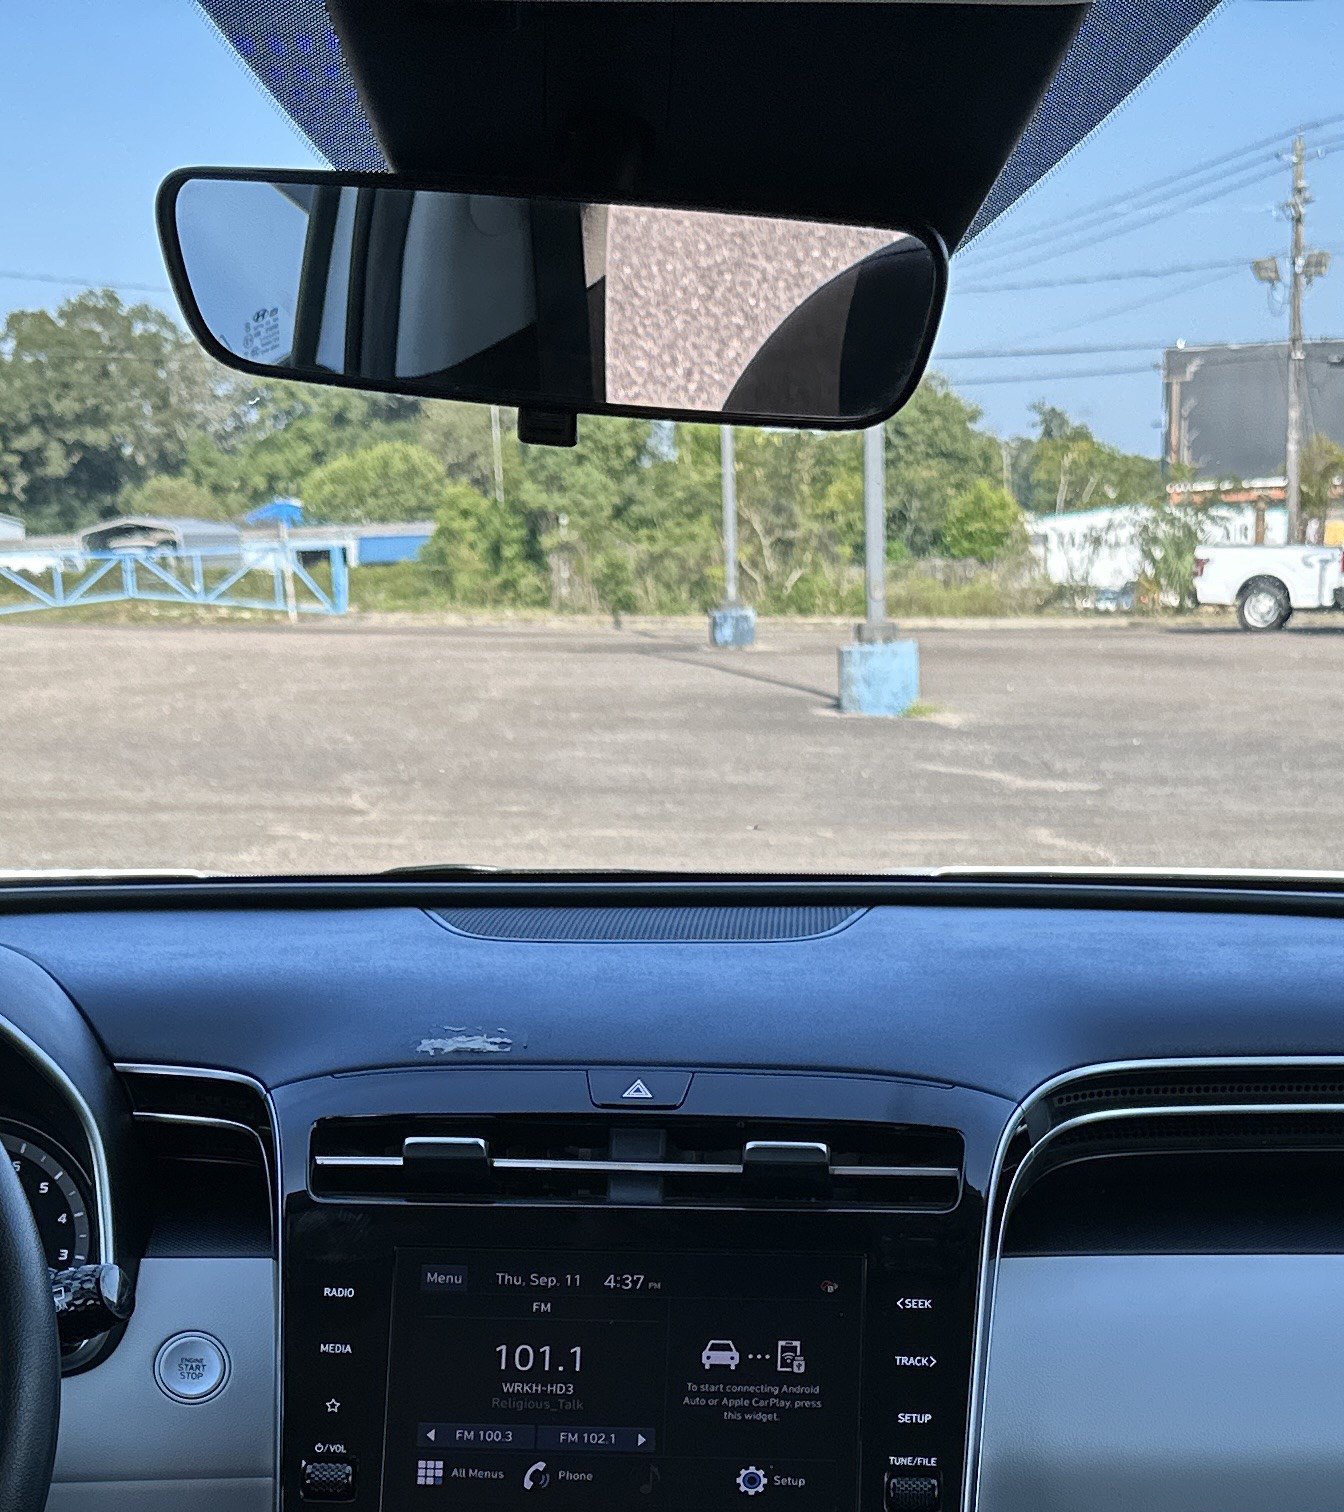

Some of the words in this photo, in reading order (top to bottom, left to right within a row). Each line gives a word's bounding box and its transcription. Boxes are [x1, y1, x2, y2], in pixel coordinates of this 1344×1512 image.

[38, 1182, 49, 1194] 5
[57, 1213, 67, 1224] 4
[58, 1249, 68, 1261] 3
[426, 1272, 462, 1285] Menu
[530, 1273, 560, 1289] Sep.
[565, 1274, 581, 1287] 11
[603, 1274, 645, 1290] 4:37
[323, 1287, 355, 1298] RADIO
[532, 1302, 551, 1313] FM
[904, 1298, 932, 1309] SEEK
[320, 1343, 352, 1354] MEDIA
[495, 1344, 583, 1372] 101.1
[895, 1355, 930, 1367] TRACK
[178, 1364, 206, 1372] START
[180, 1372, 203, 1380] STOP
[502, 1381, 575, 1395] WRKH-HD3
[687, 1382, 698, 1392] To
[700, 1383, 724, 1392] start
[725, 1383, 779, 1395] connecting
[781, 1384, 820, 1395] Android
[682, 1396, 706, 1406] Auto
[708, 1398, 719, 1406] or
[721, 1397, 750, 1408] Apple
[794, 1399, 823, 1409] press
[723, 1410, 742, 1420] this
[897, 1413, 932, 1424] SETUP
[455, 1429, 474, 1441] FM
[478, 1430, 513, 1442] 100.3
[559, 1431, 578, 1443] FM
[583, 1432, 616, 1445] 102.1
[889, 1456, 937, 1467] TUNE/FILE
[451, 1468, 466, 1478] All
[469, 1468, 505, 1480] Menus
[558, 1469, 594, 1481] Phone
[773, 1475, 806, 1488] Setup
